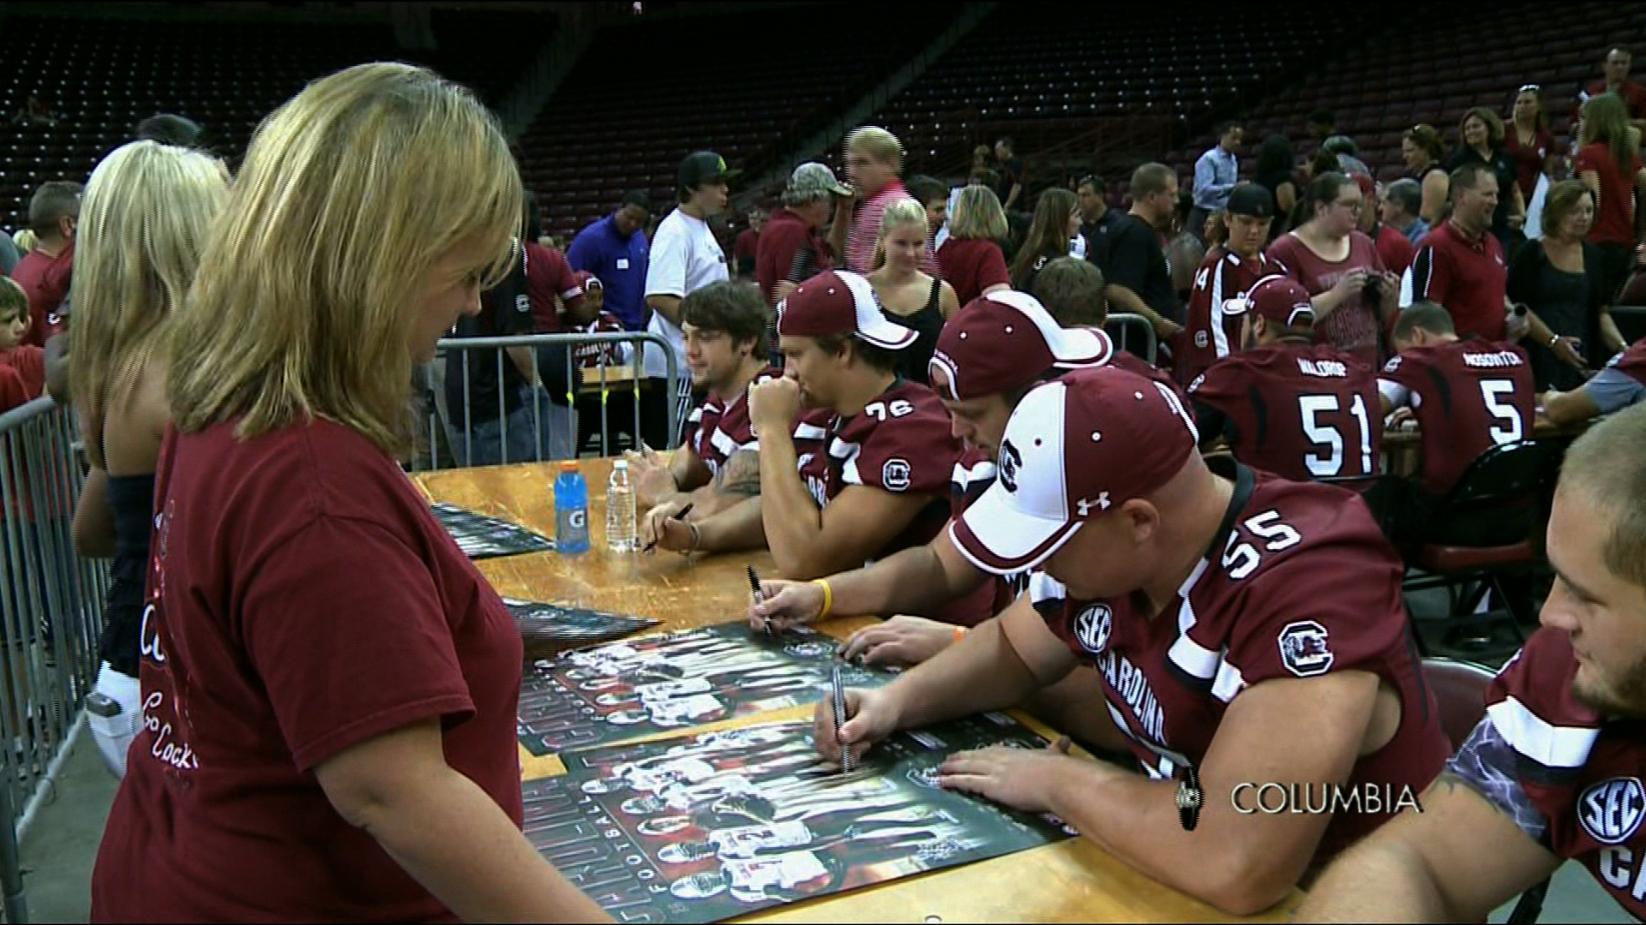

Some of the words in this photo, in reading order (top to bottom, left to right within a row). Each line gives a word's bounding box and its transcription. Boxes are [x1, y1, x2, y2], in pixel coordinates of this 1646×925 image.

[864, 400, 914, 421] 76
[1299, 394, 1372, 476] 51
[1479, 380, 1523, 445] 5
[569, 510, 585, 529] G
[1220, 510, 1302, 579] 55
[1079, 607, 1110, 649] SEC
[1097, 649, 1167, 747] CAROLINA
[1585, 781, 1640, 838] SEC
